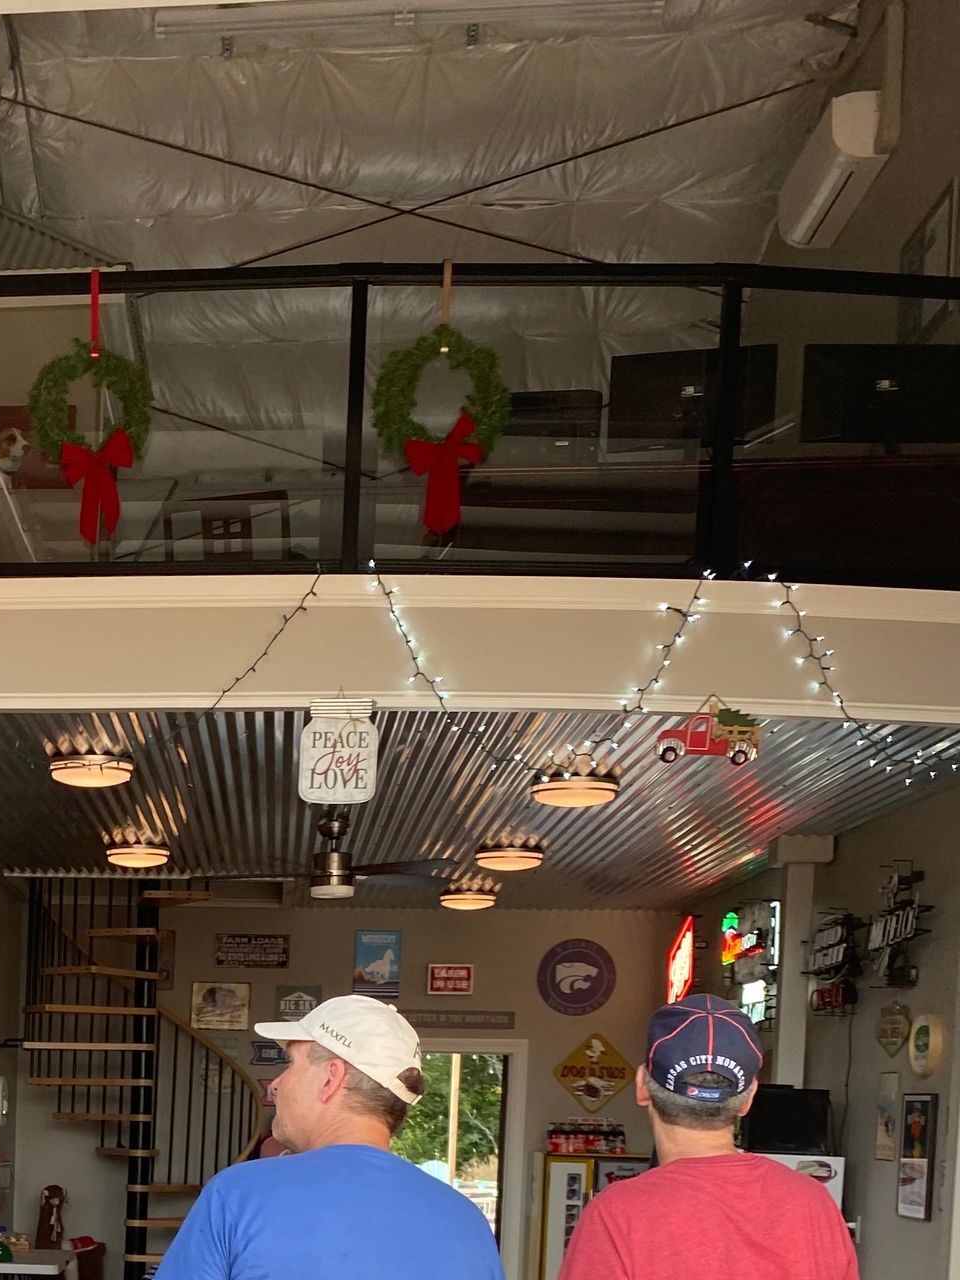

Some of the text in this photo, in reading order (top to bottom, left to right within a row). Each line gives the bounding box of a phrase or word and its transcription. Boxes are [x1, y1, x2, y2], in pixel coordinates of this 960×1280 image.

[312, 731, 369, 748] PEACE
[314, 739, 367, 784] Joy
[309, 768, 368, 790] LOVE
[561, 1065, 586, 1078] DOG
[666, 1060, 688, 1091] KANSAS
[689, 1055, 713, 1066] CITY
